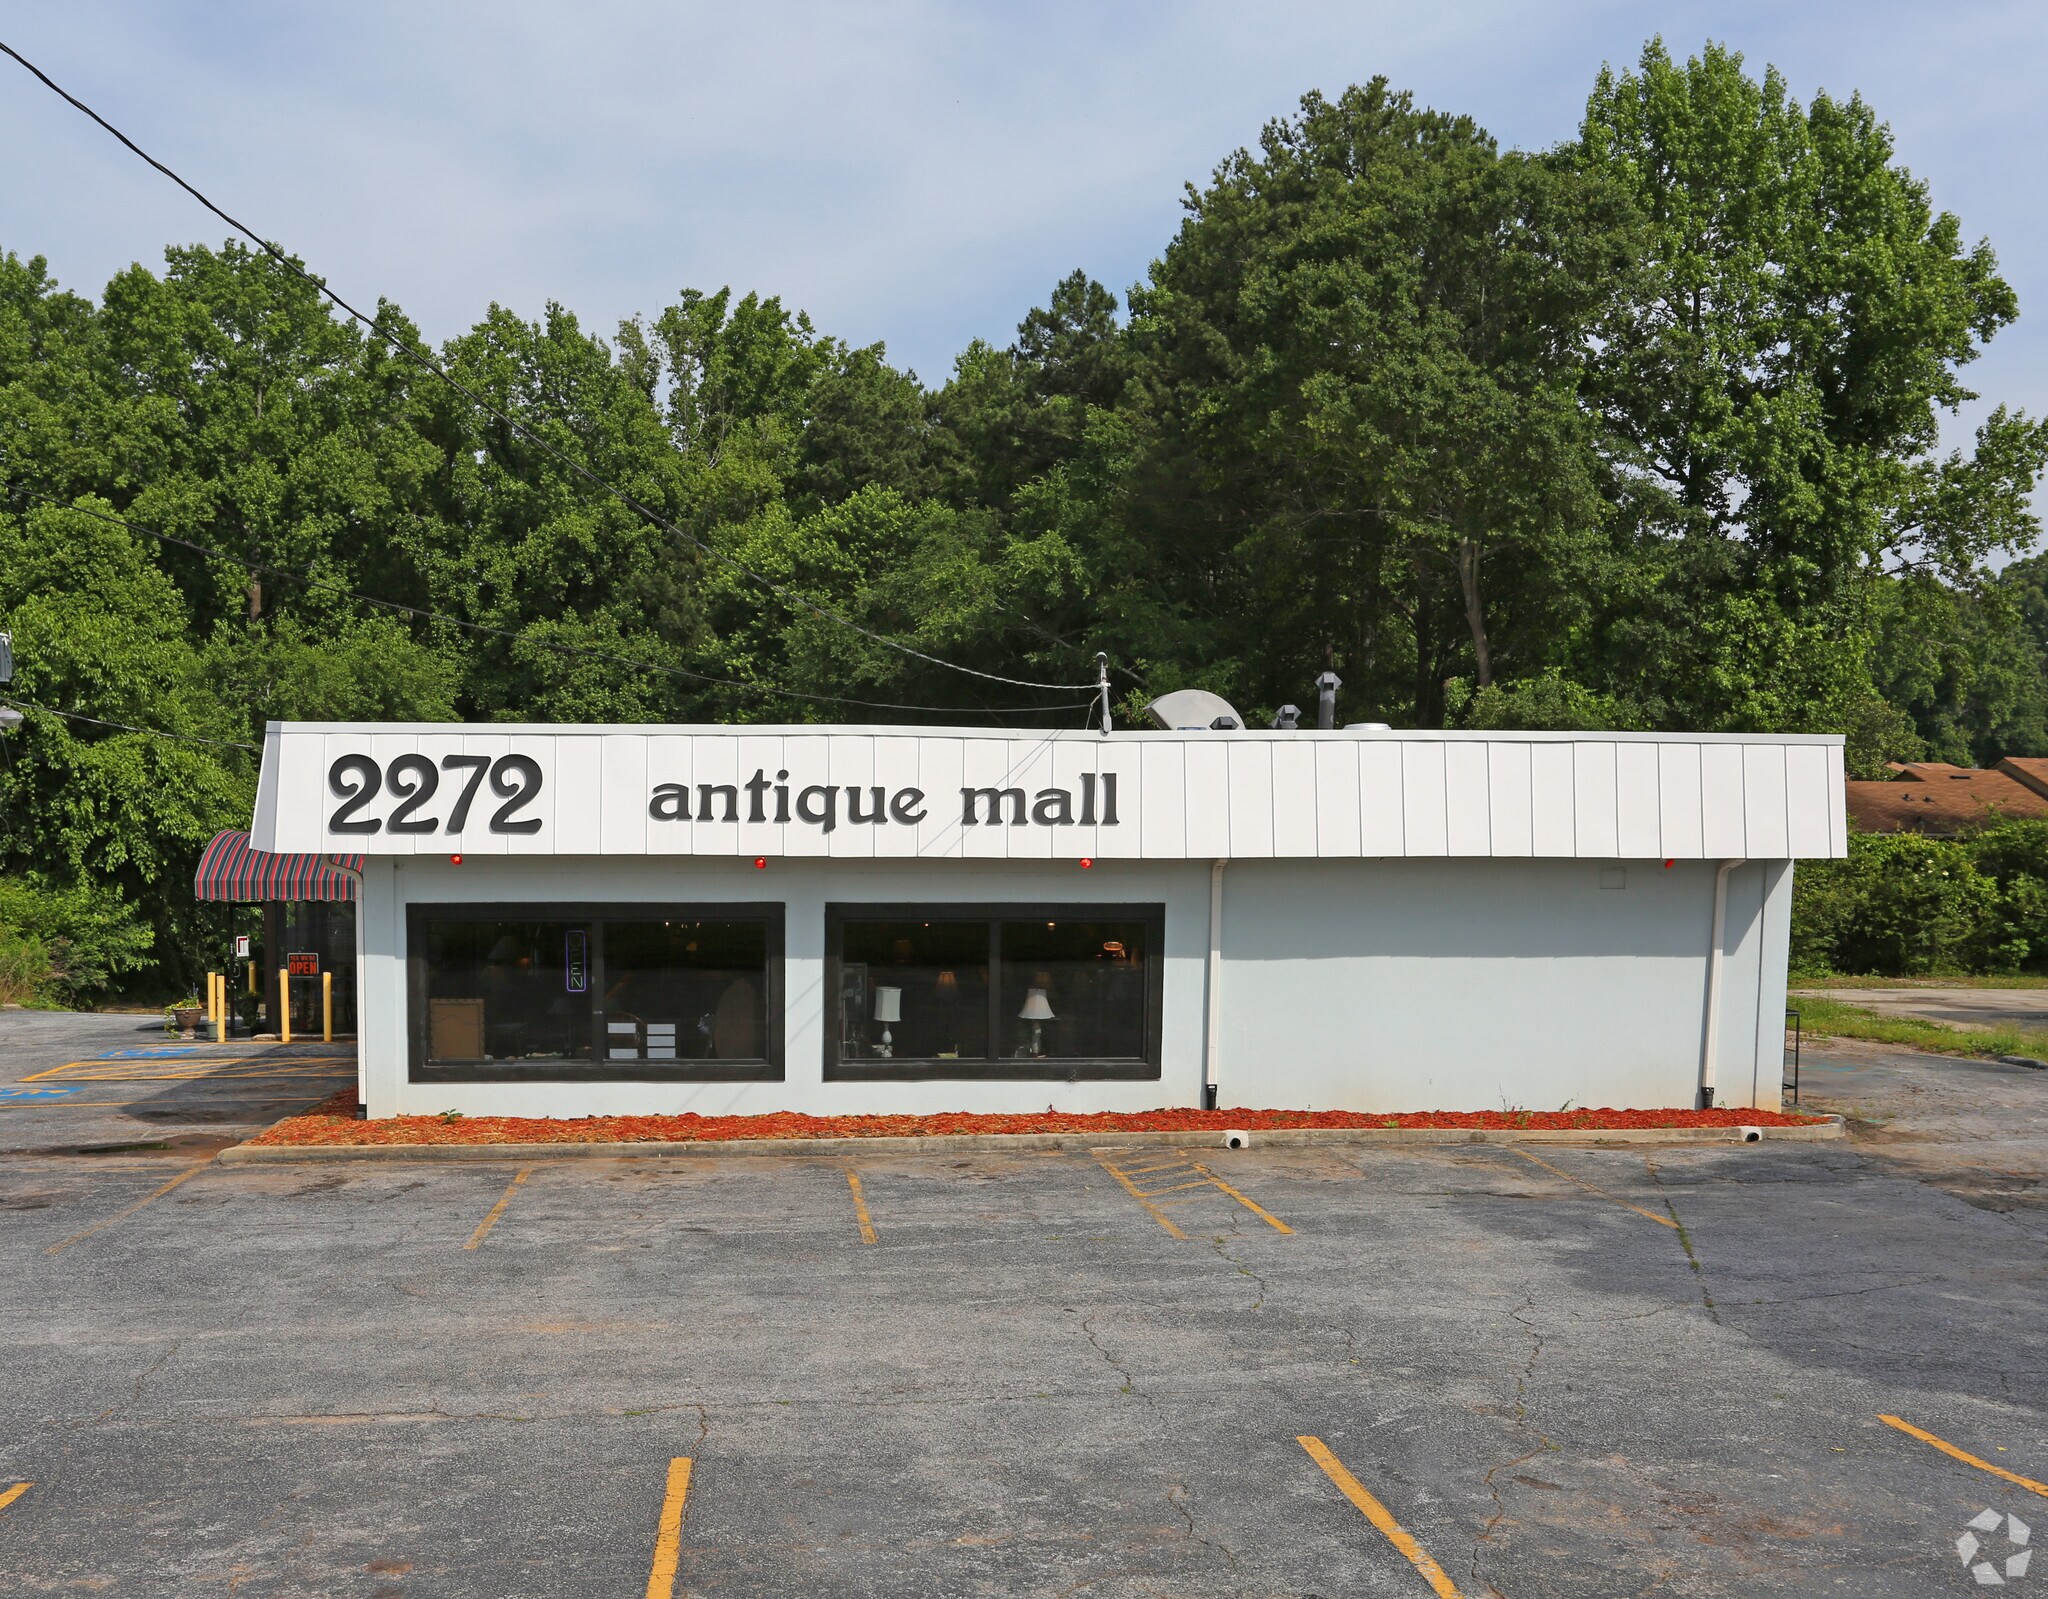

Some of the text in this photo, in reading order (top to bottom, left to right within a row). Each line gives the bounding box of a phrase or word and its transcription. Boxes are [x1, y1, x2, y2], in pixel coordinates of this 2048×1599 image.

[328, 754, 543, 833] 2272
[649, 769, 1120, 833] antique mall
[290, 961, 317, 975] OPEN
